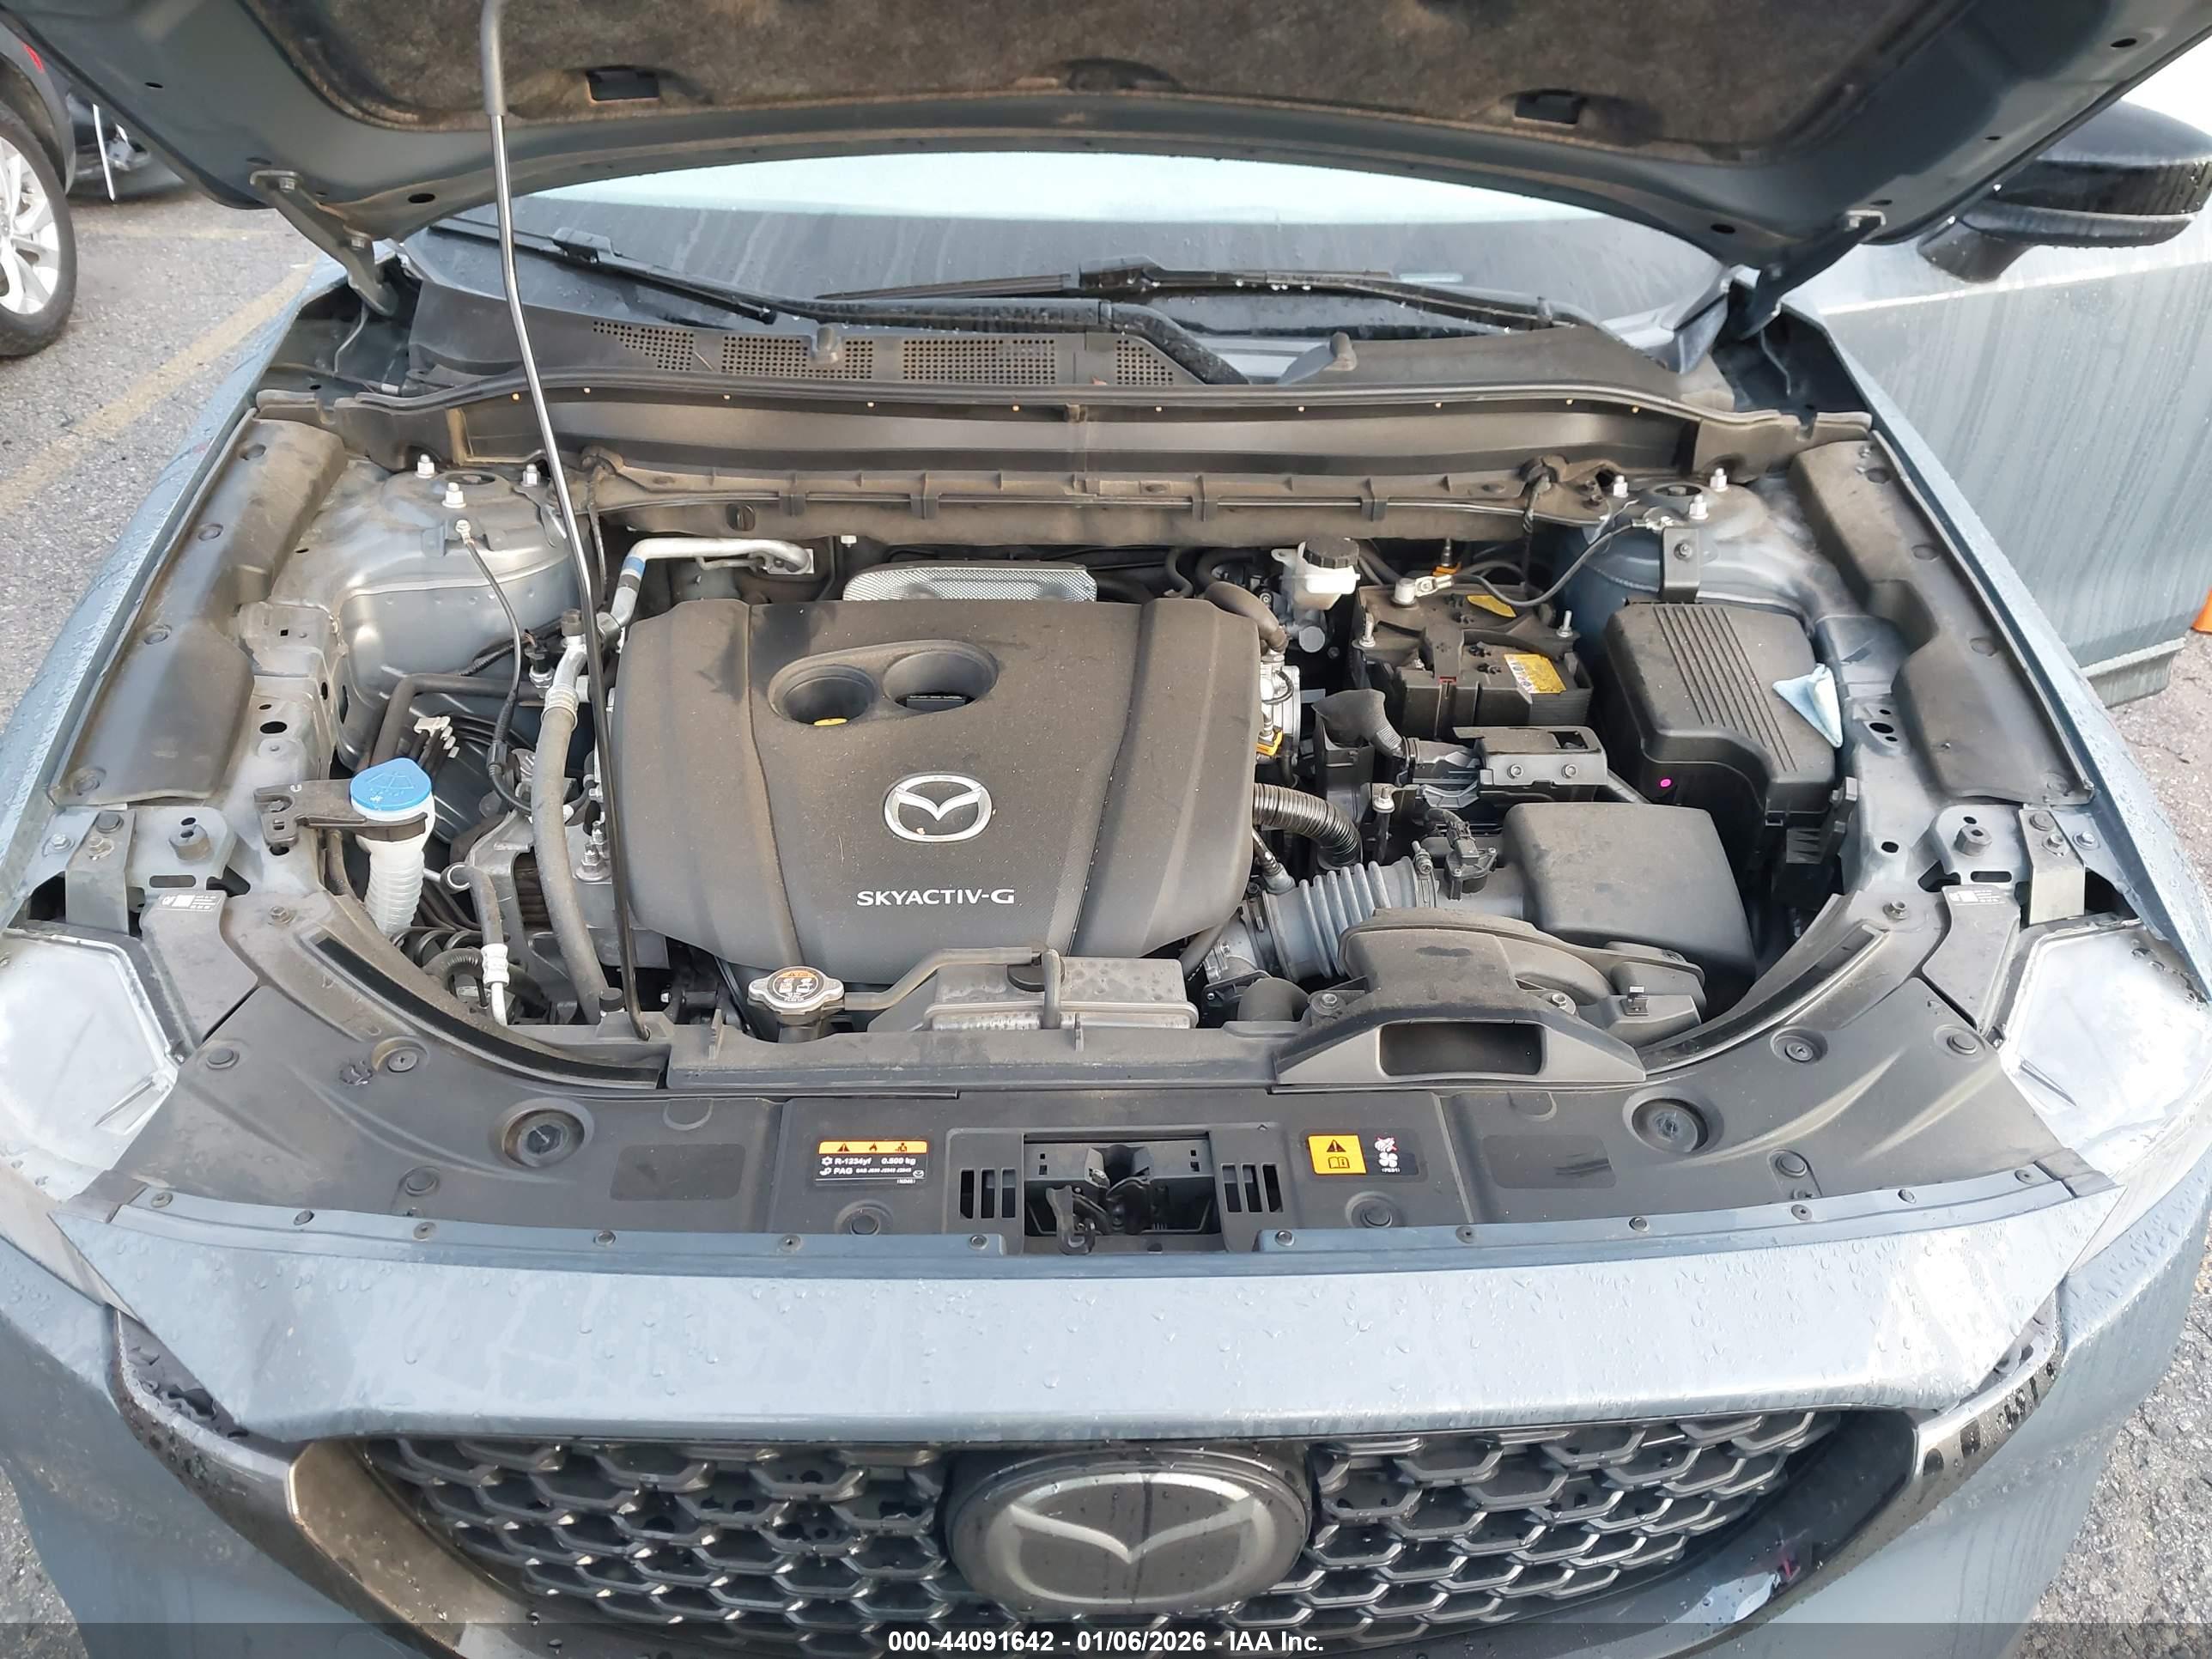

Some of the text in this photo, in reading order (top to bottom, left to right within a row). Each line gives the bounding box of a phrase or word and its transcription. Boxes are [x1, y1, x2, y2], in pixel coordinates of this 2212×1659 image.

[856, 889, 1015, 906] SKYACTIV-G
[834, 1157, 872, 1167] R-1234yf
[904, 1157, 916, 1167] kg
[833, 1167, 854, 1176] PAG
